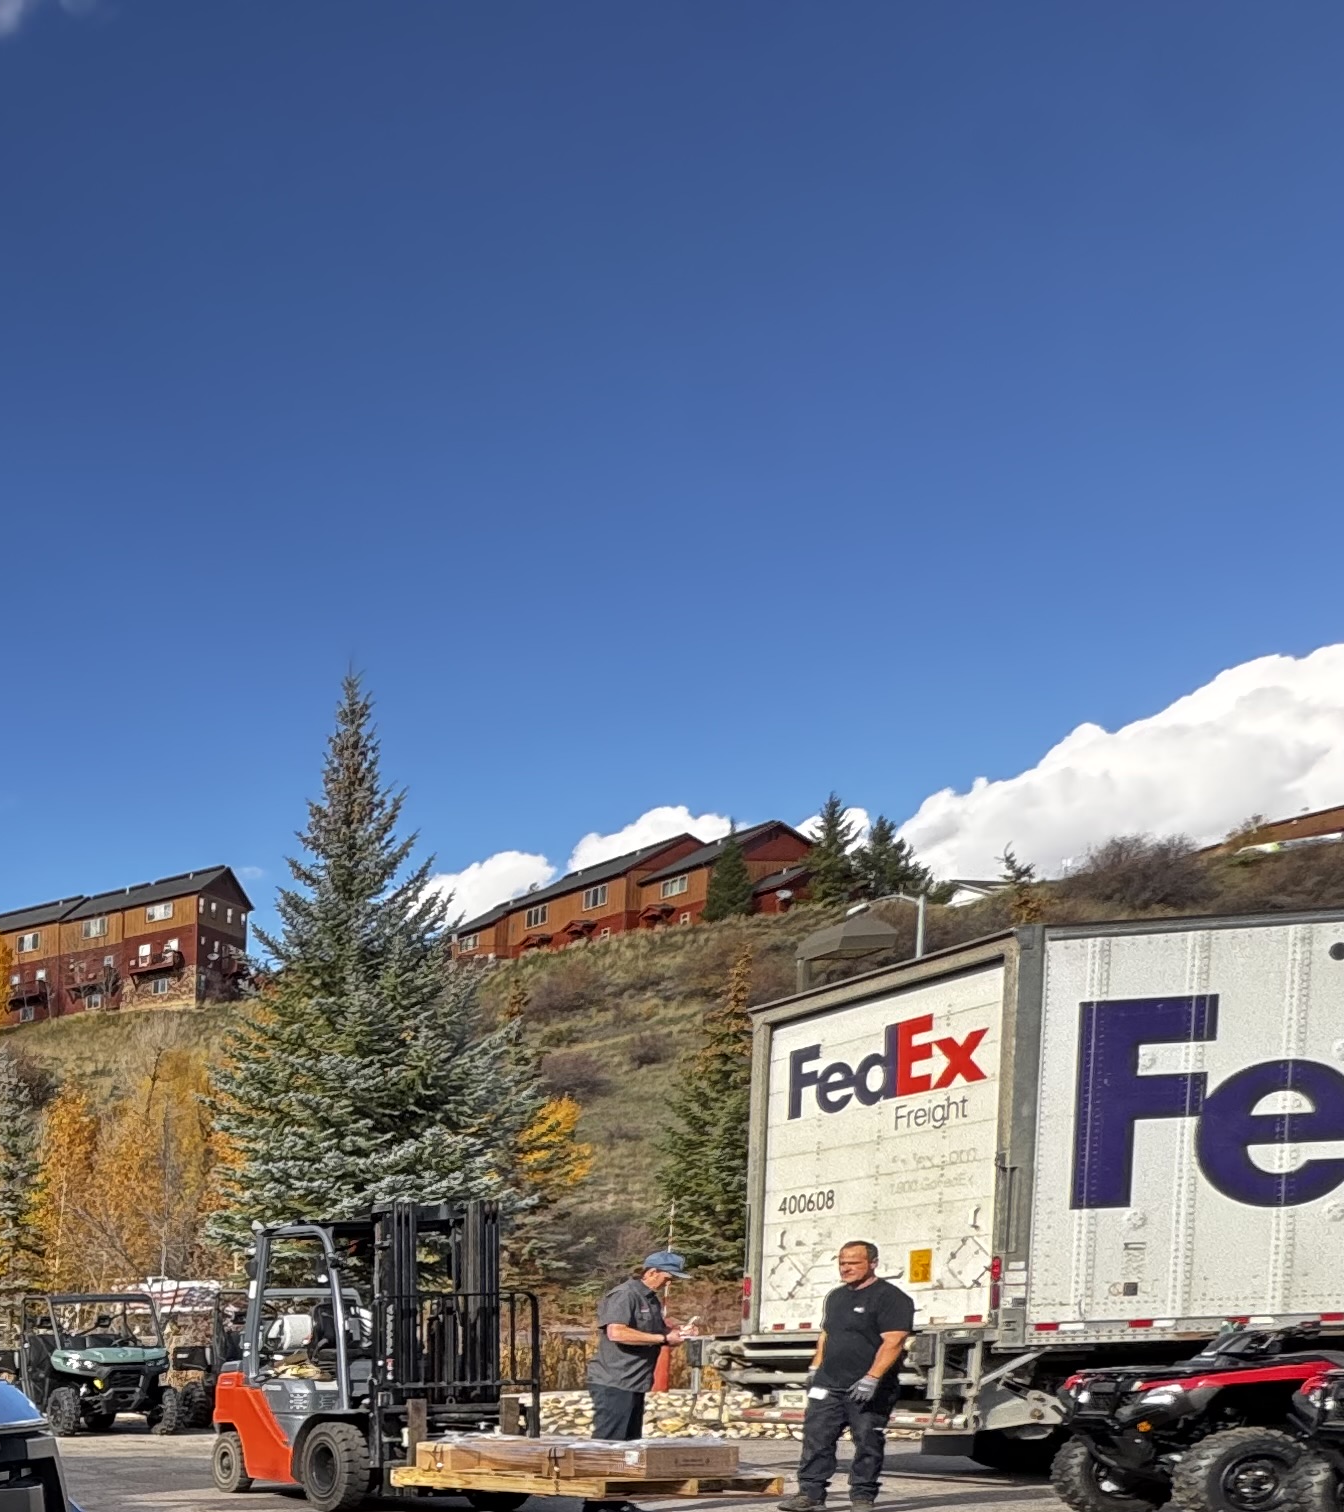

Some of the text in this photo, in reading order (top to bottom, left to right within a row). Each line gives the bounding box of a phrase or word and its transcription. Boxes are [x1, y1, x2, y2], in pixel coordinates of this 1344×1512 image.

[787, 1013, 990, 1121] FedEx
[894, 1095, 969, 1132] Freight
[778, 1189, 836, 1216] 400608
